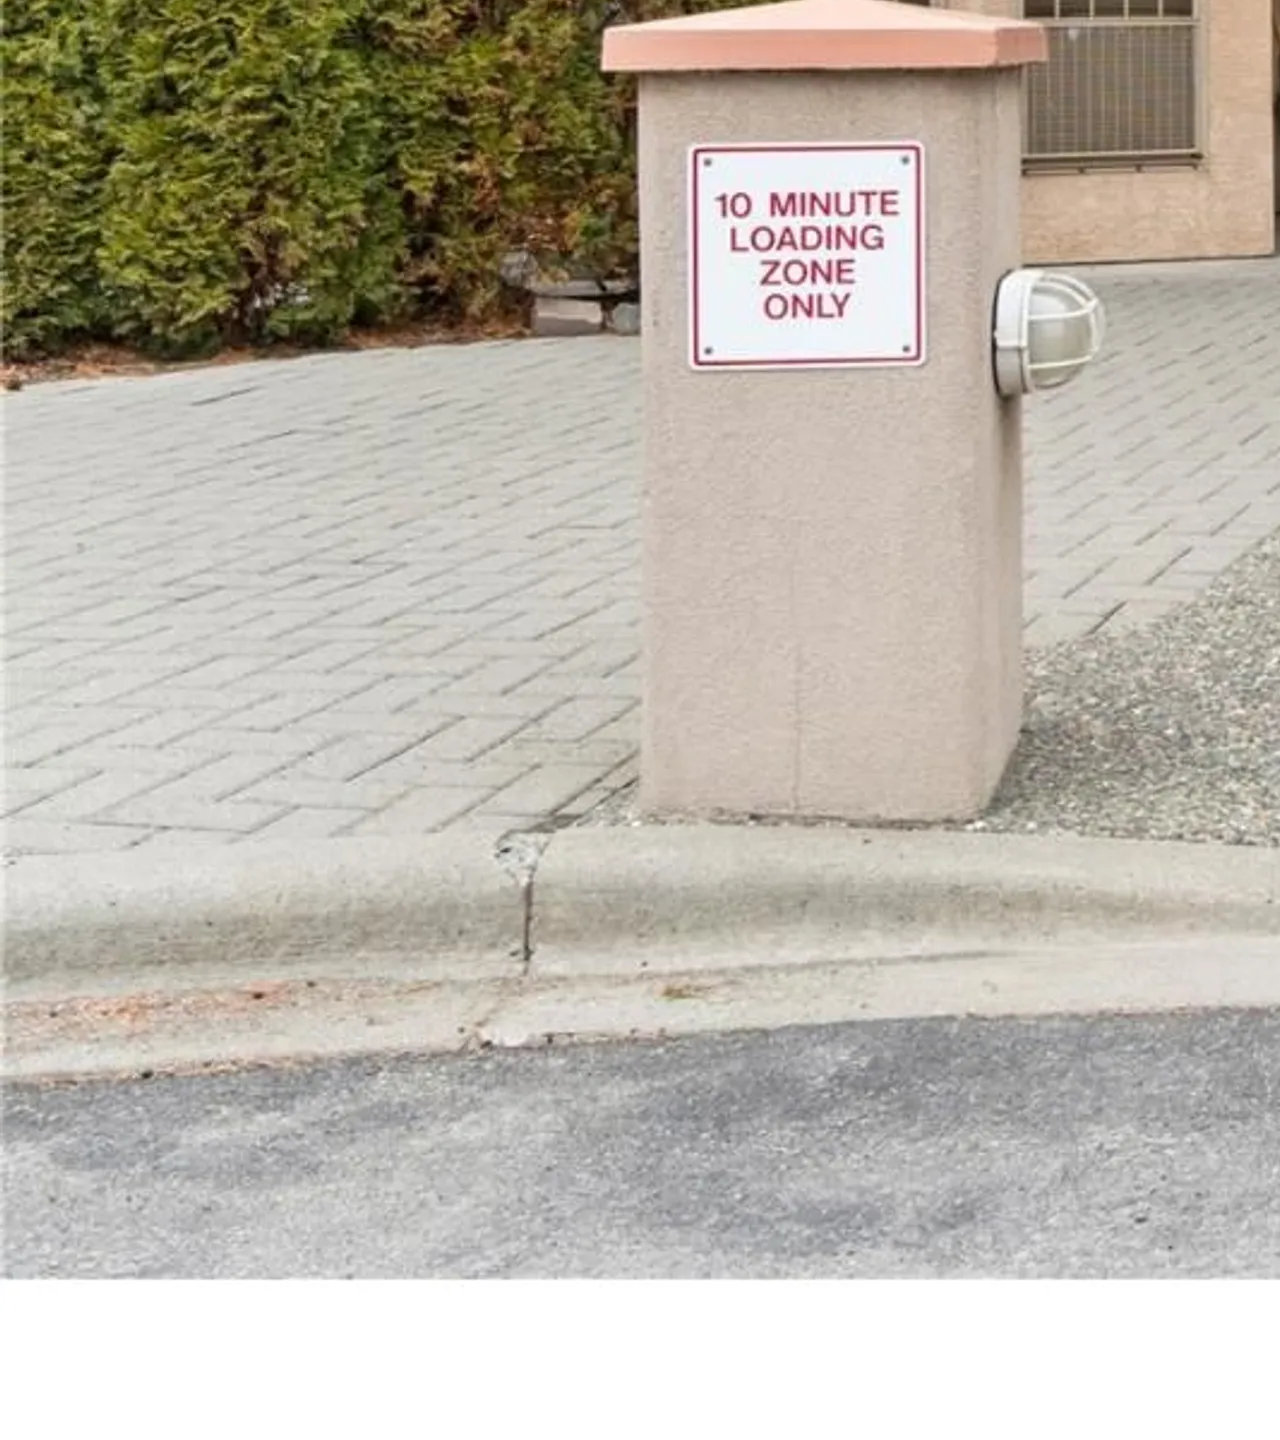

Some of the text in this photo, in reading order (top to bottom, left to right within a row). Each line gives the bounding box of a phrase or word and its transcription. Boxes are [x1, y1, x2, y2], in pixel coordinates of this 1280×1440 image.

[714, 189, 900, 219] 10 MINUTE
[729, 224, 886, 253] LOADING
[759, 258, 856, 286] ZONE
[763, 292, 852, 321] ONLY
